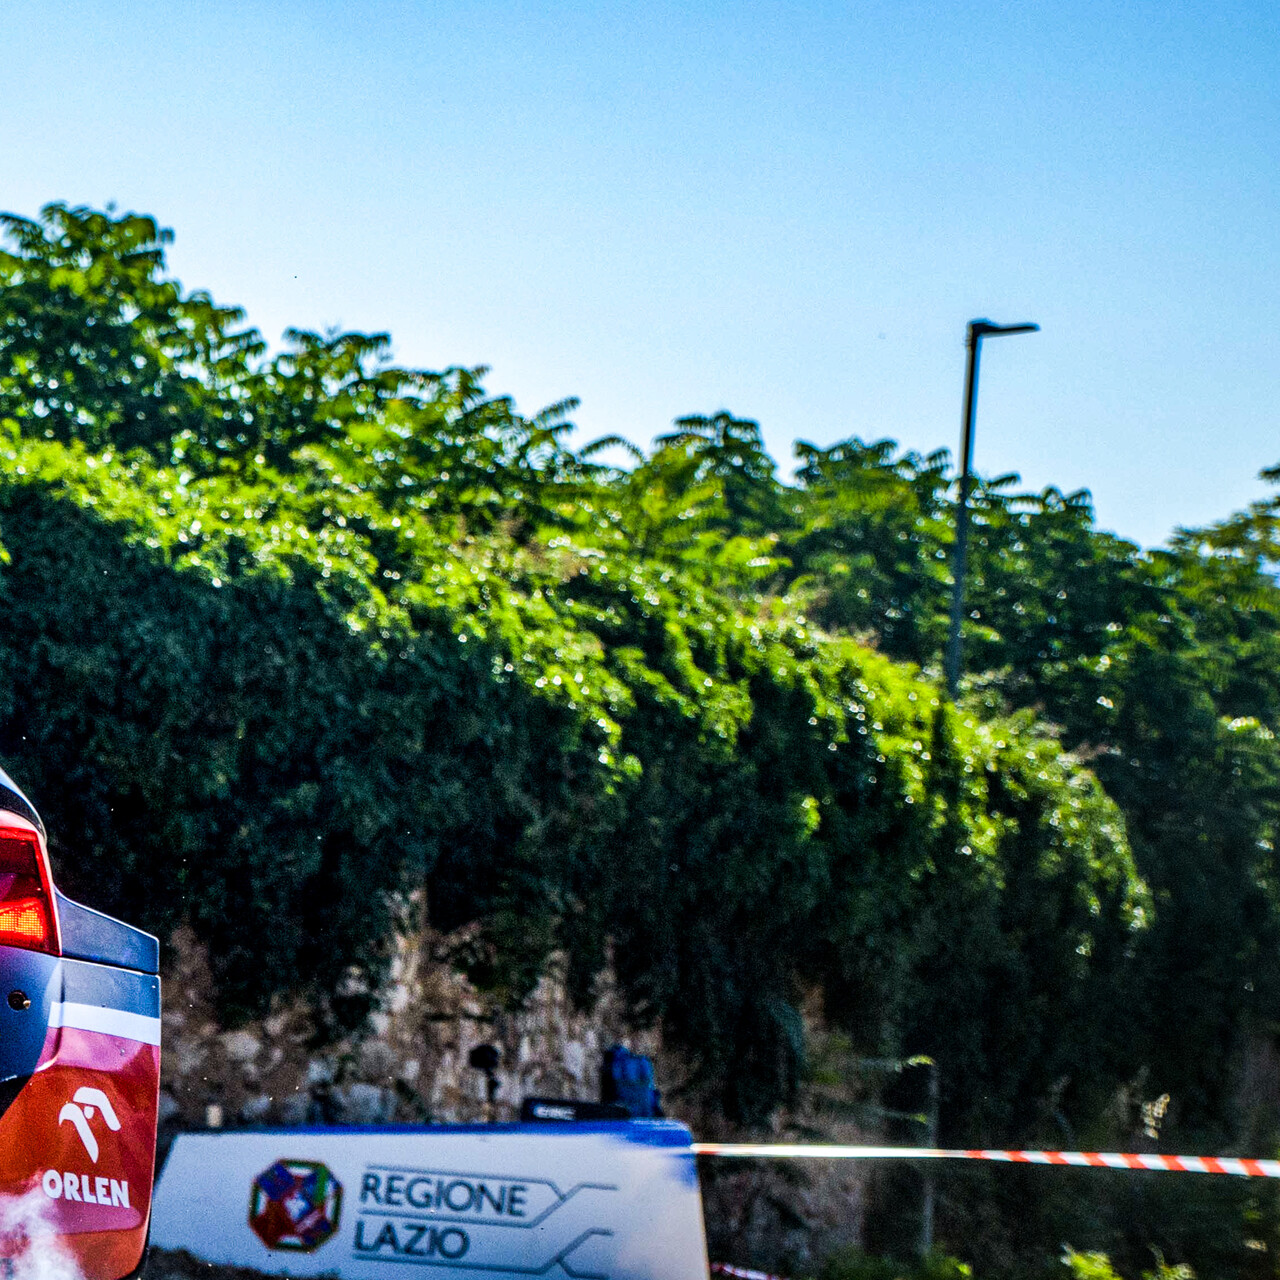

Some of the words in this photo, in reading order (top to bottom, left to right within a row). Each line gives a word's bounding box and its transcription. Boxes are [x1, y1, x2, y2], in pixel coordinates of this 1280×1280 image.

[41, 1169, 131, 1209] ORLEN
[360, 1172, 528, 1217] REGIONE
[354, 1220, 470, 1259] LAZIO
